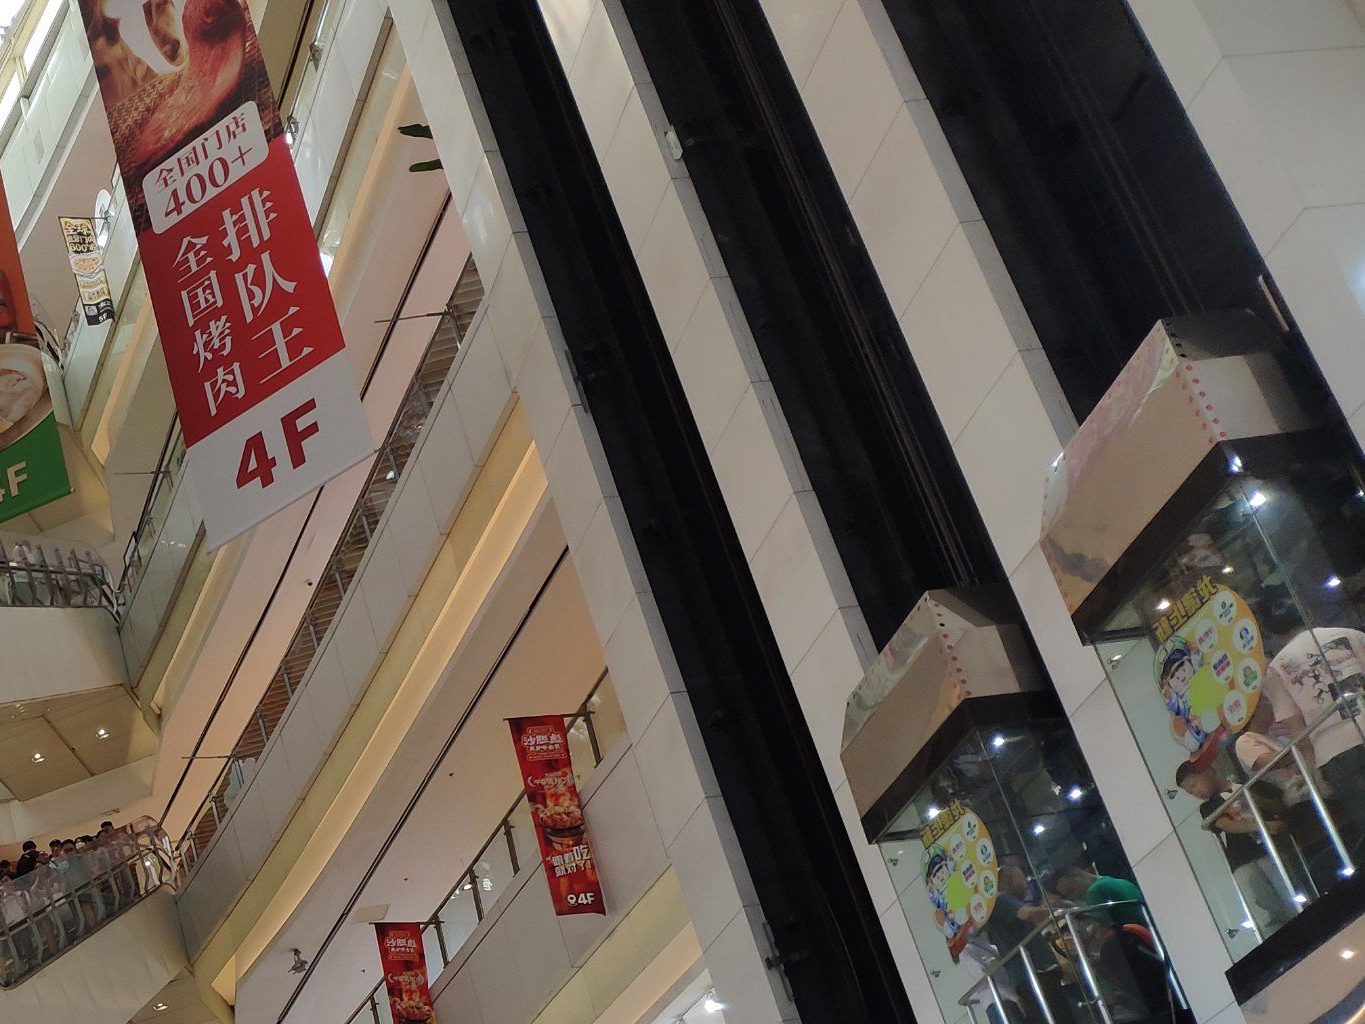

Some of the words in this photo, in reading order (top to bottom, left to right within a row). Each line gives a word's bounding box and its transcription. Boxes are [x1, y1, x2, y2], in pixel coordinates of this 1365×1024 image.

[155, 112, 248, 194] 全国门店
[164, 145, 253, 218] 400+
[172, 235, 246, 417] 全国烤肉
[219, 187, 315, 384] 排队王
[236, 397, 320, 489] 4F
[577, 892, 595, 905] 4F
